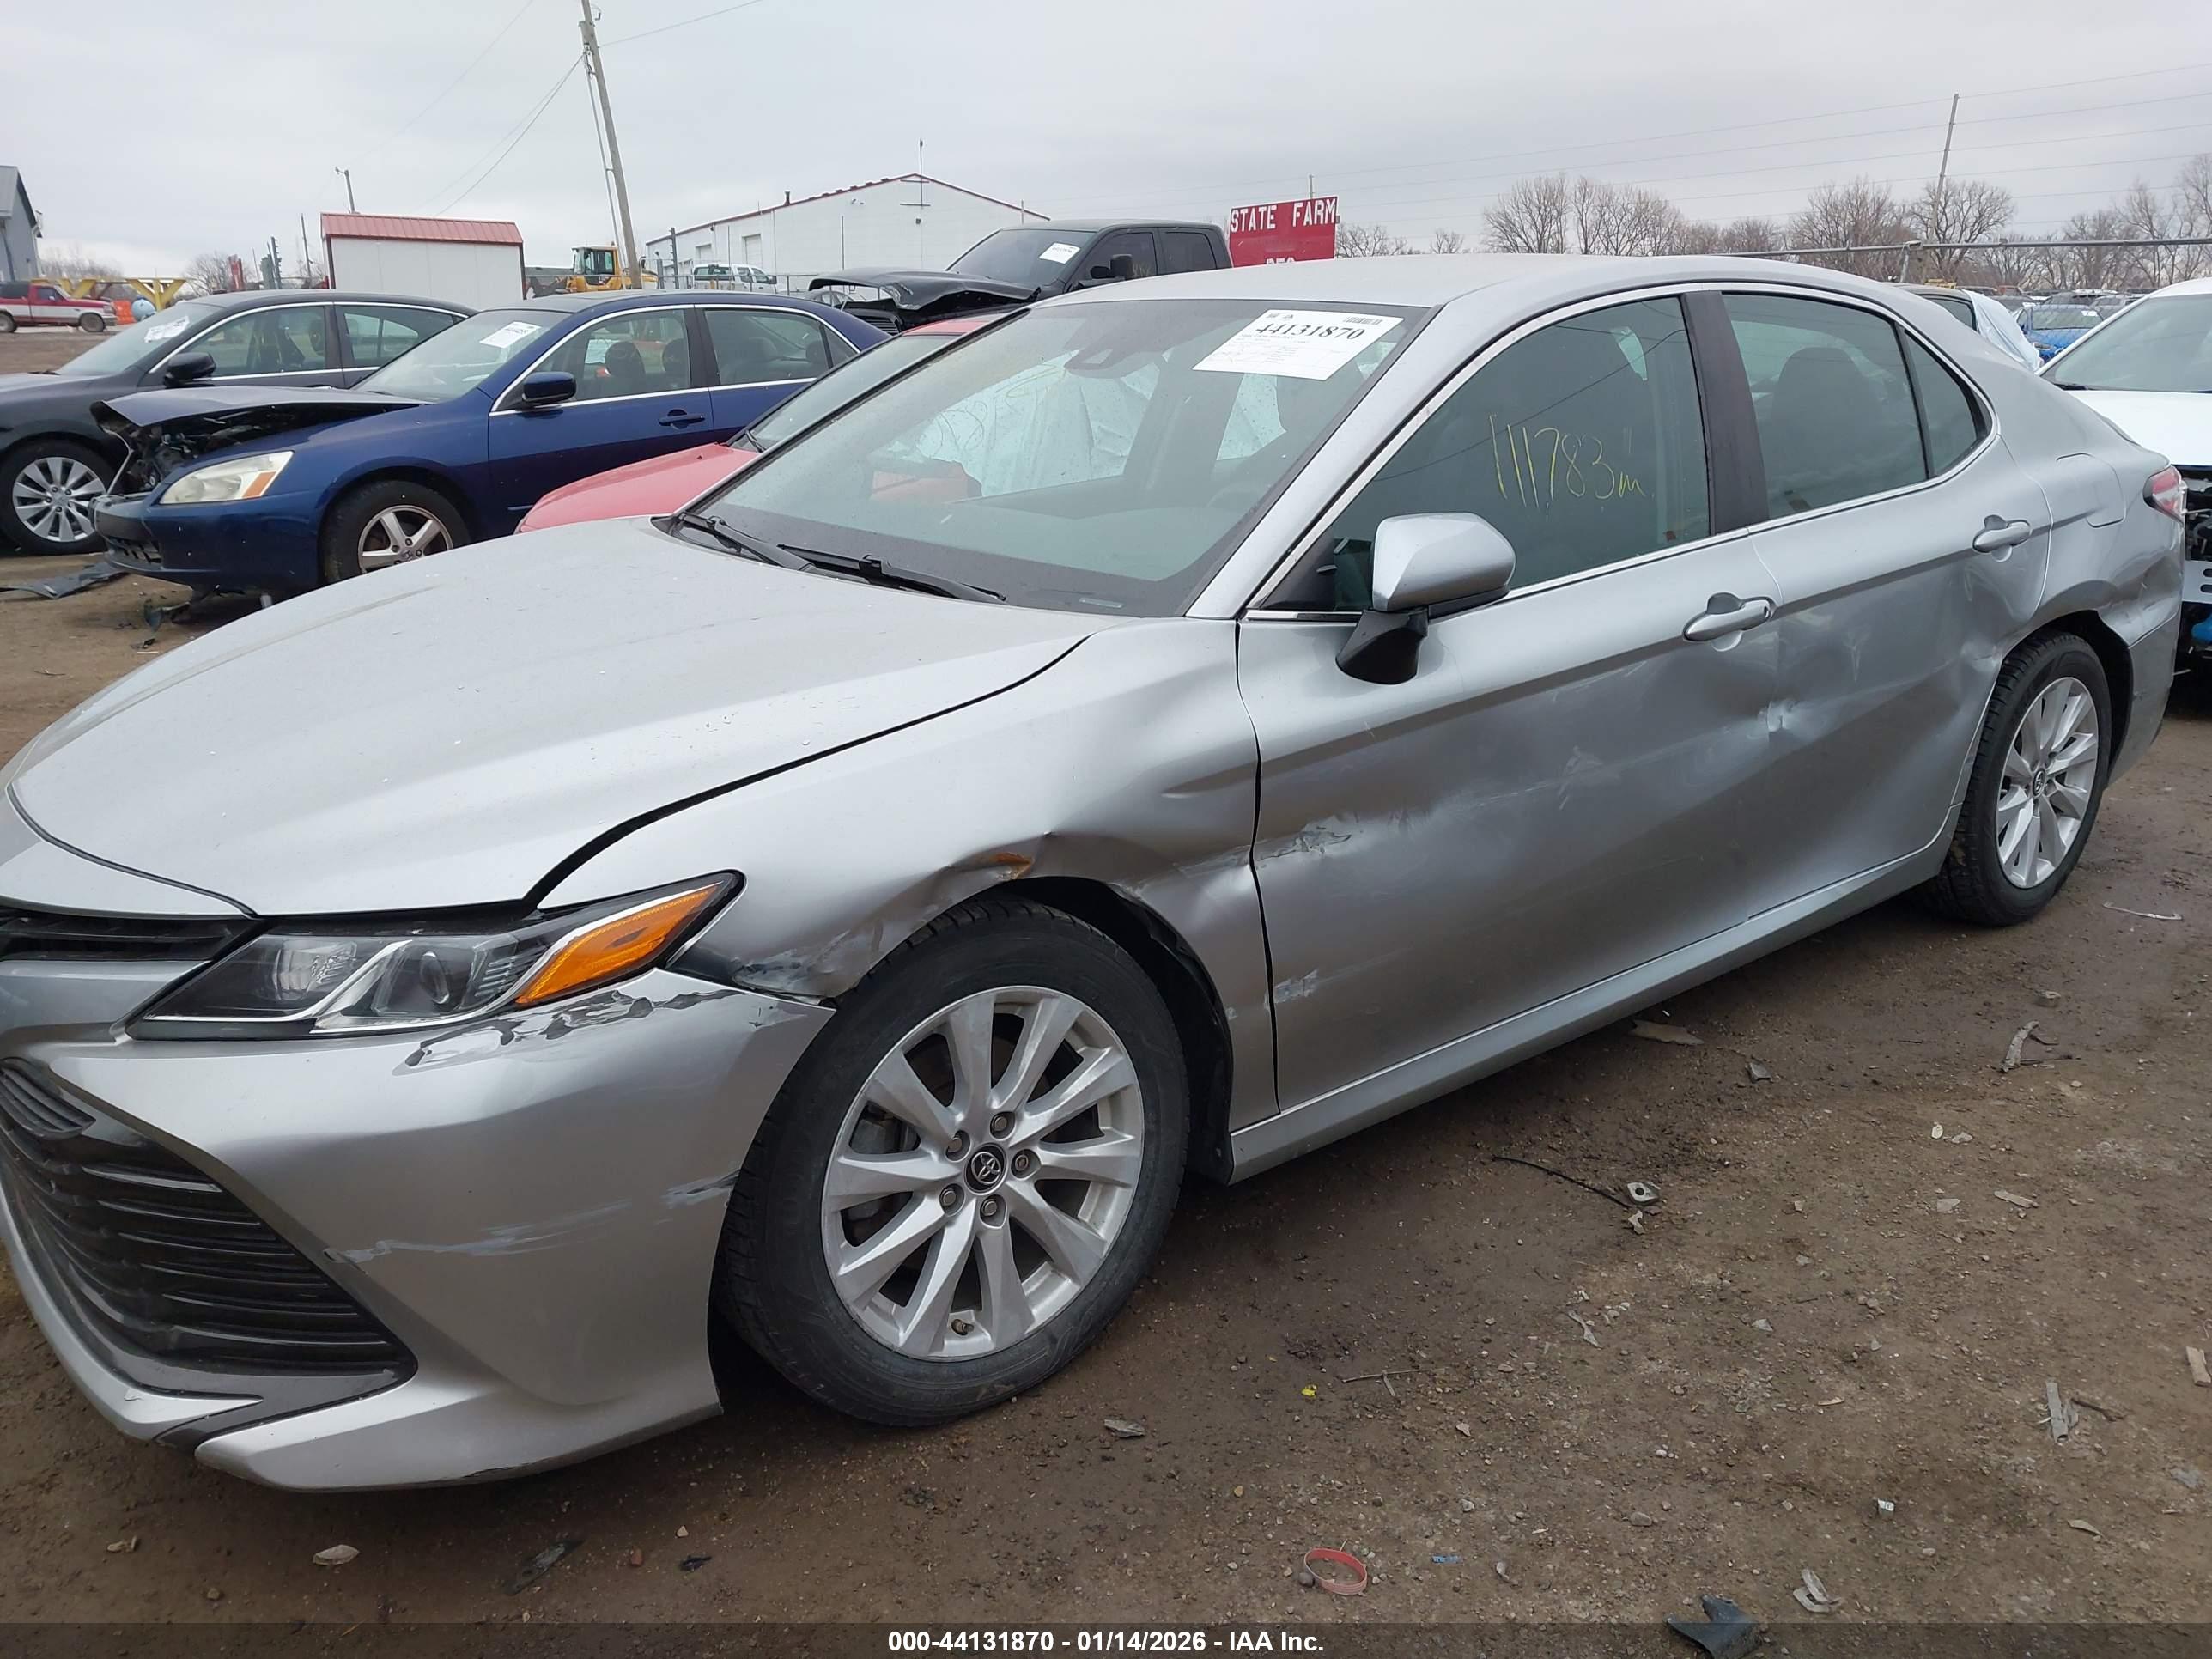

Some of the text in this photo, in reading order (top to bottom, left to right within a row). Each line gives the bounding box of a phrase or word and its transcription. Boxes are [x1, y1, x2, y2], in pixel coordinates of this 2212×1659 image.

[1231, 198, 1336, 233] STATE FARM
[1255, 322, 1366, 340] 44131870
